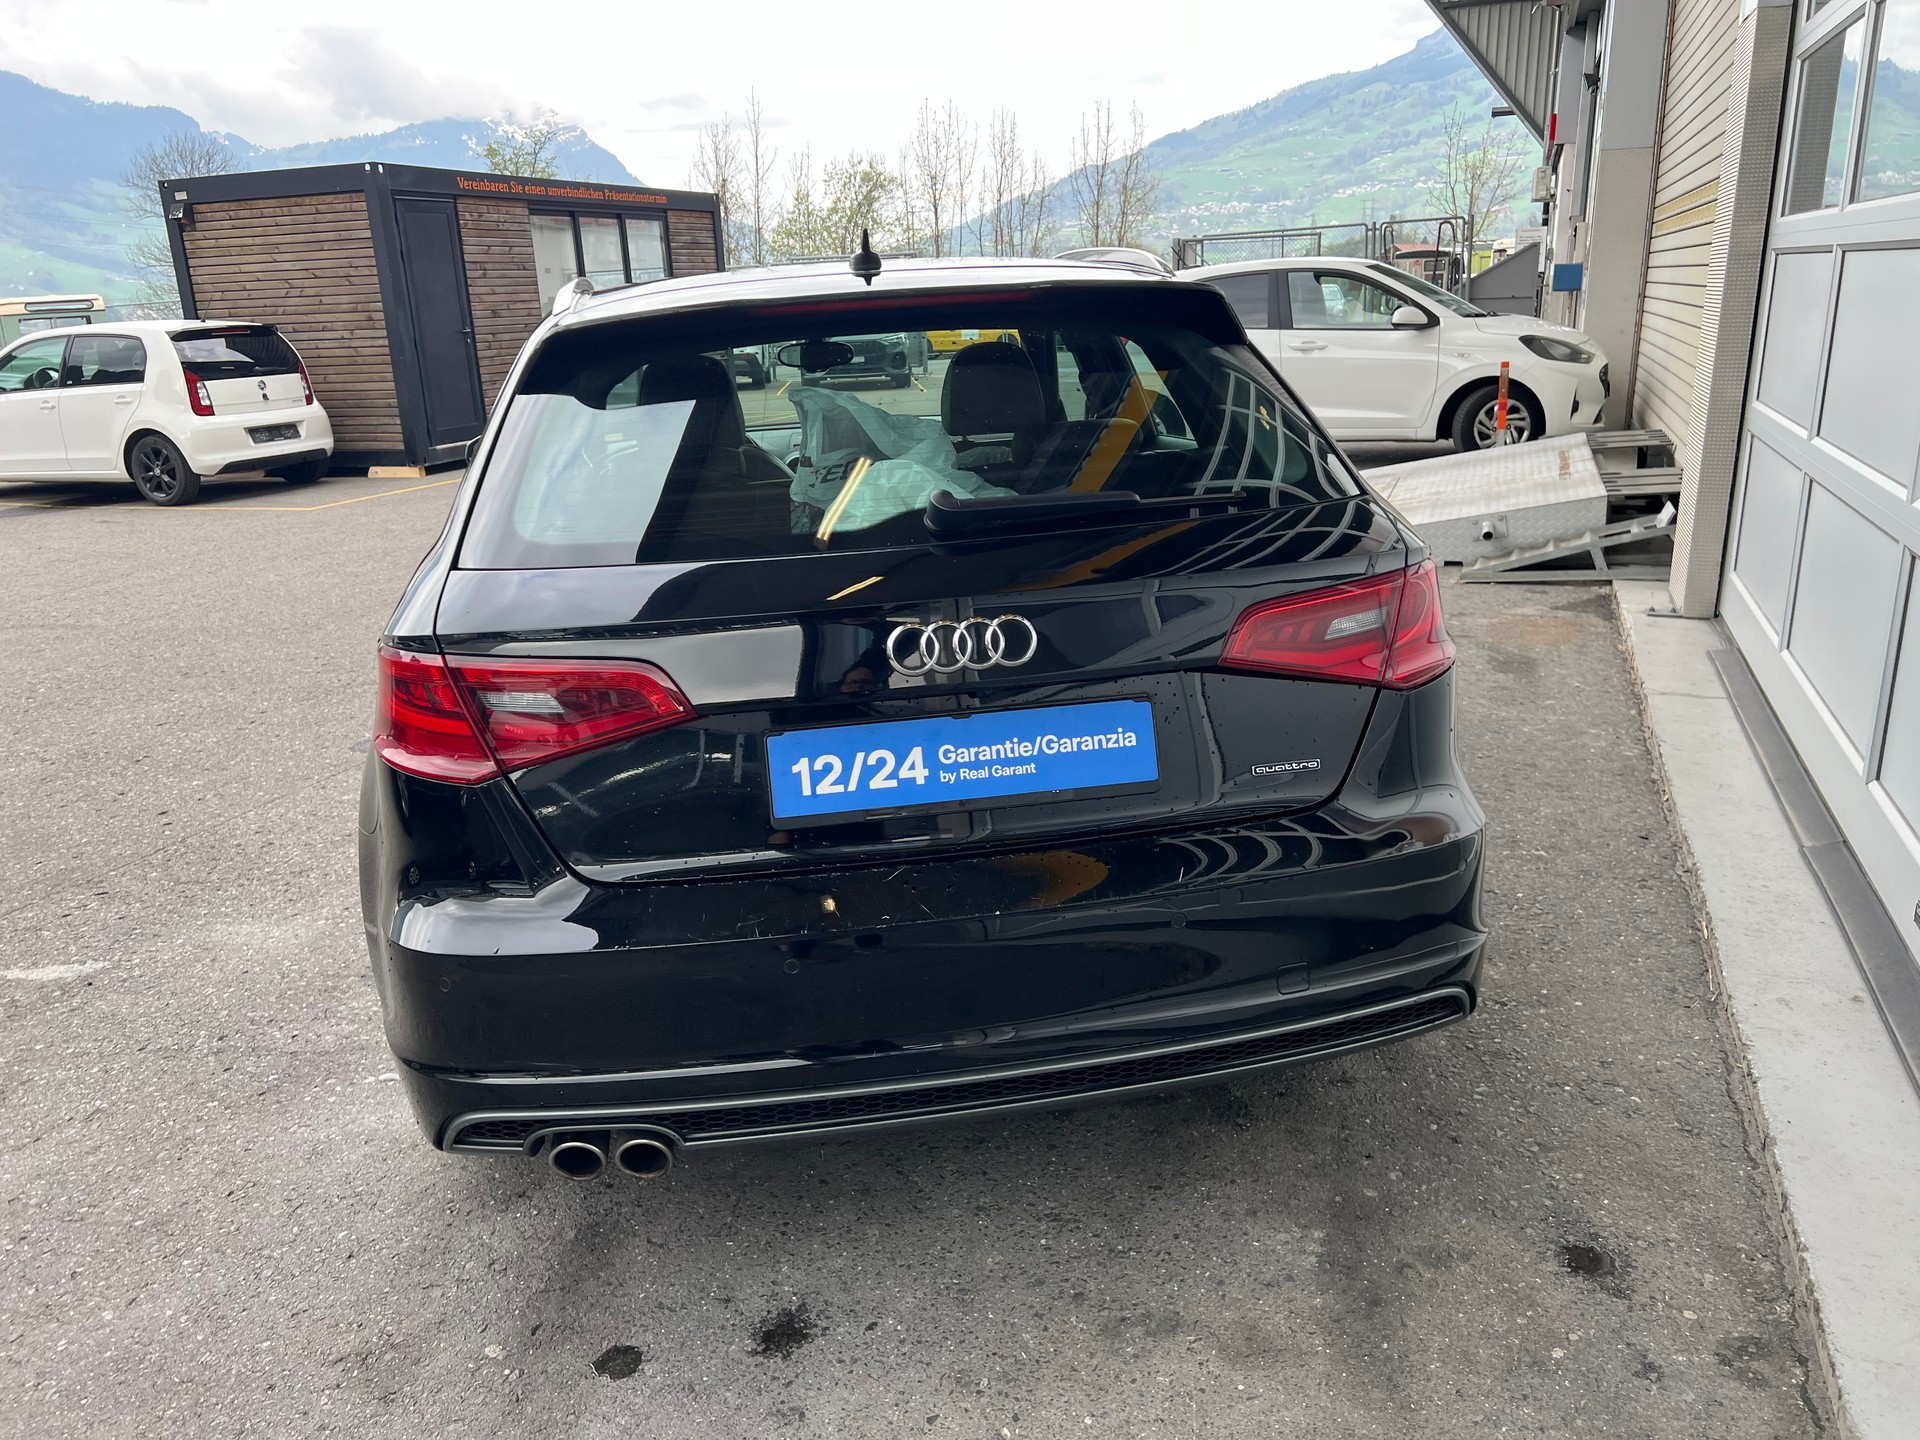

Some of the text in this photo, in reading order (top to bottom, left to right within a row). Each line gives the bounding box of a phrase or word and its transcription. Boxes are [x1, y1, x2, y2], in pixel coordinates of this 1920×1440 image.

[456, 177, 667, 203] Vereinbaren Sie einen unverbindlichen Präsentationstermin
[938, 727, 1137, 764] Garantie/Garanzia
[791, 746, 930, 796] 12/24
[939, 762, 1037, 784] by Real Garant
[1255, 761, 1318, 774] quattro
